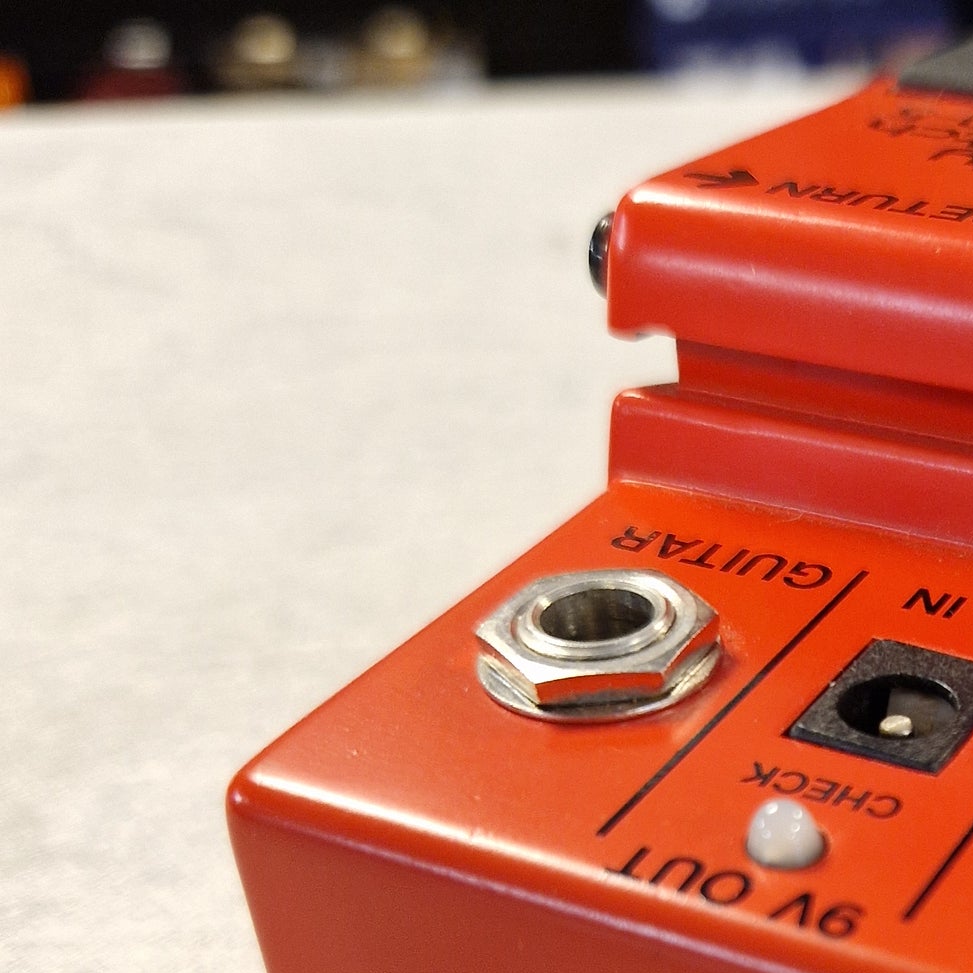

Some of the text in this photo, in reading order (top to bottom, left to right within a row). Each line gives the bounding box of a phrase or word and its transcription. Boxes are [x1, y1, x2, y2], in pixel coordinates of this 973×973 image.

[611, 525, 834, 590] GUITAR
[902, 587, 968, 620] IN
[739, 761, 904, 820] CHECK
[602, 845, 865, 940] 9V OUT
